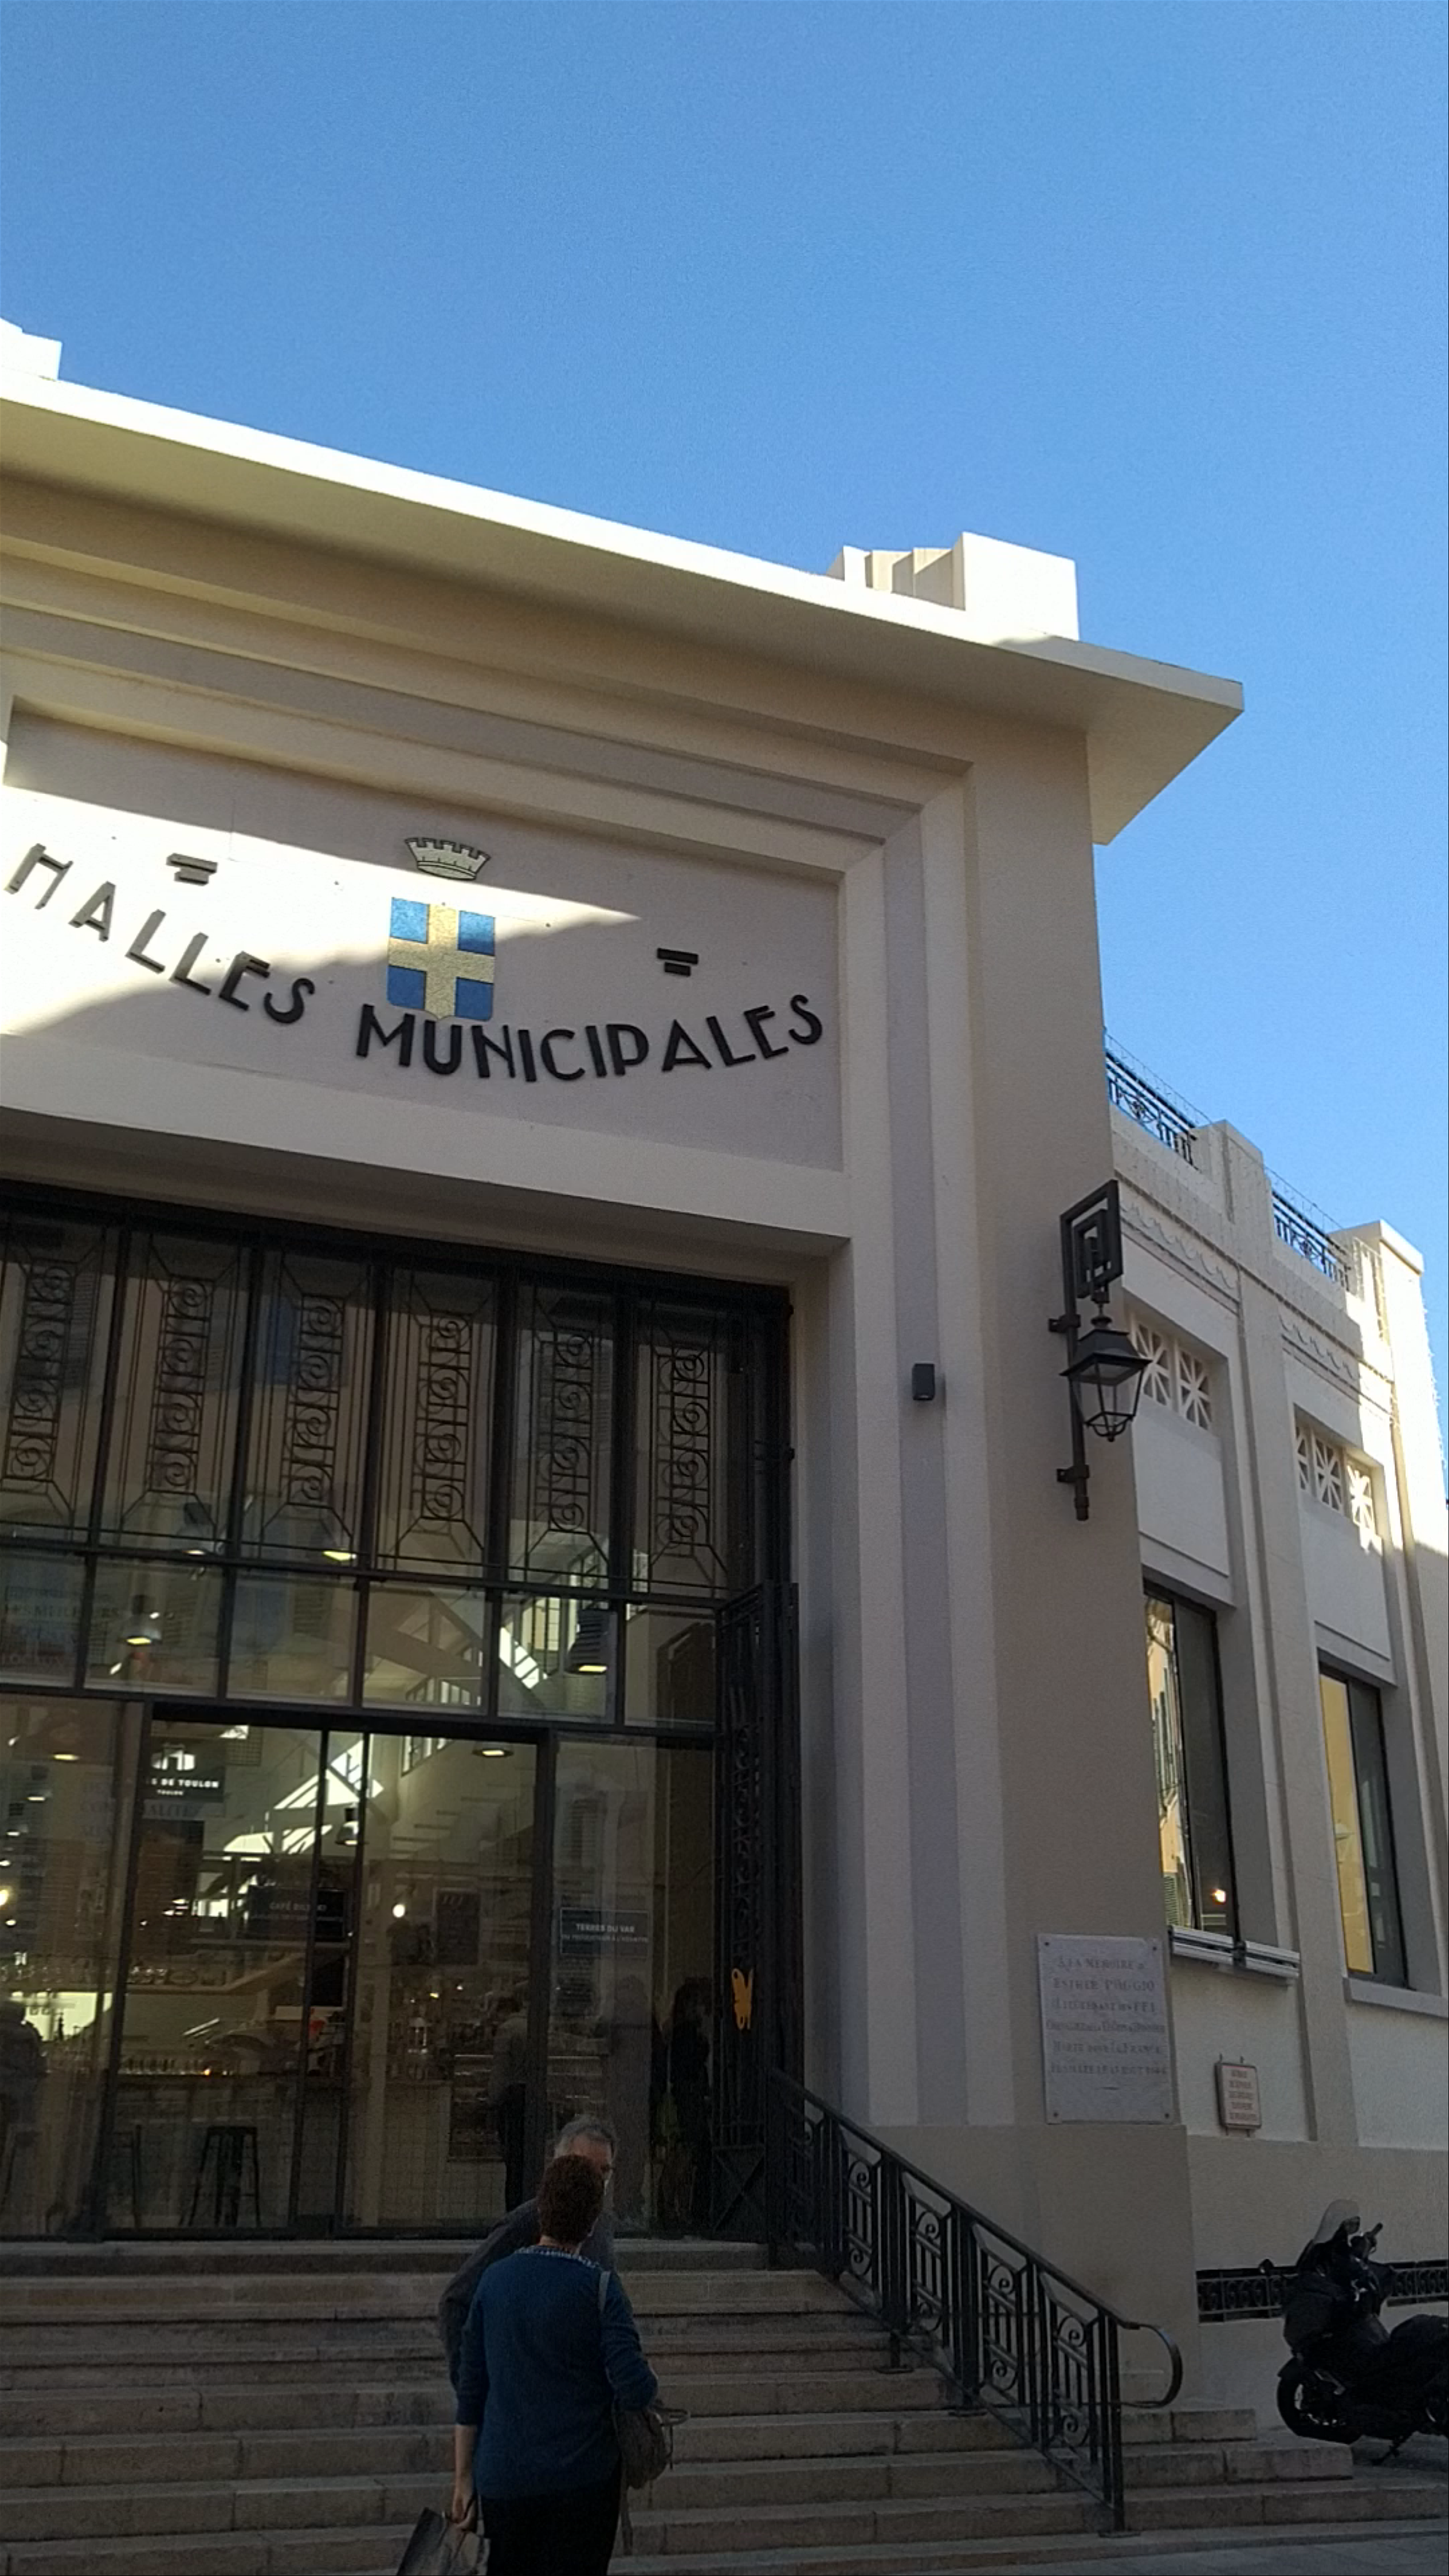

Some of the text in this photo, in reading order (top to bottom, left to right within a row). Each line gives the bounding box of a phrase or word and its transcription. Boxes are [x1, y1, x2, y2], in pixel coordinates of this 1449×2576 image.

[5, 843, 823, 1083] HALLES MUNICIPALES
[178, 1779, 219, 1789] TOULON
[576, 1923, 605, 1932] TERRES
